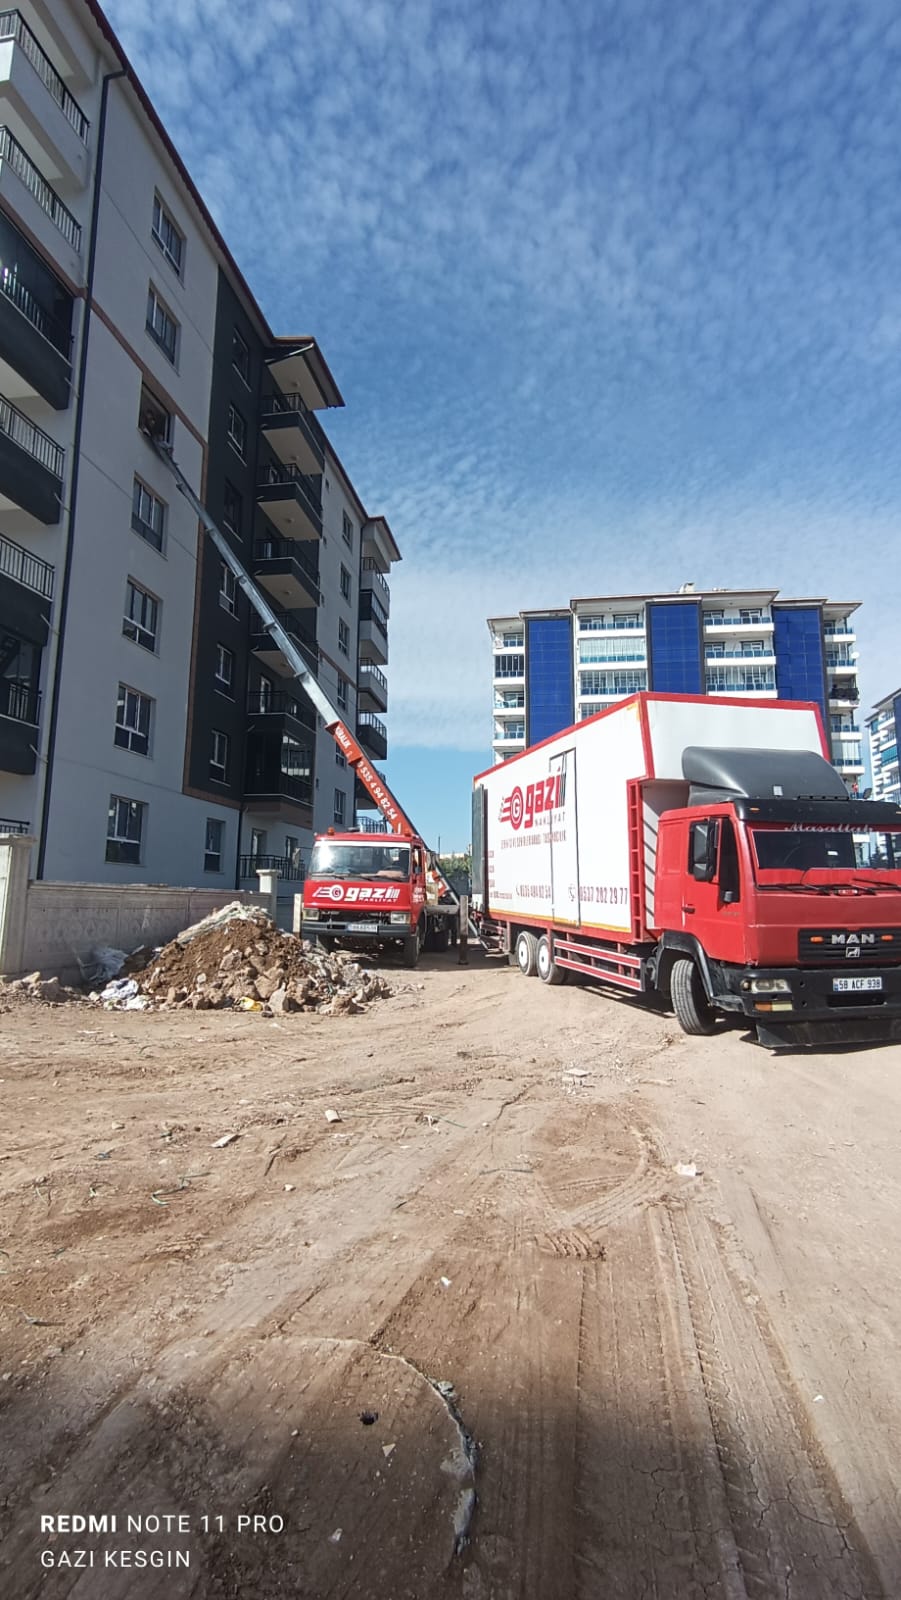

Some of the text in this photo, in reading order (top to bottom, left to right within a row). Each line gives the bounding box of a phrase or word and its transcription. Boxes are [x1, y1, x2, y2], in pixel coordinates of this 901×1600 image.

[361, 767, 373, 782] 535
[374, 787, 384, 799] 94
[381, 798, 391, 809] 82
[387, 808, 397, 819] 54
[524, 766, 561, 829] gazi
[344, 886, 395, 902] gazi
[609, 887, 618, 904] 29
[619, 887, 628, 905] 77
[831, 934, 875, 944] MAN
[839, 980, 848, 989] 58
[852, 980, 865, 989] ACF
